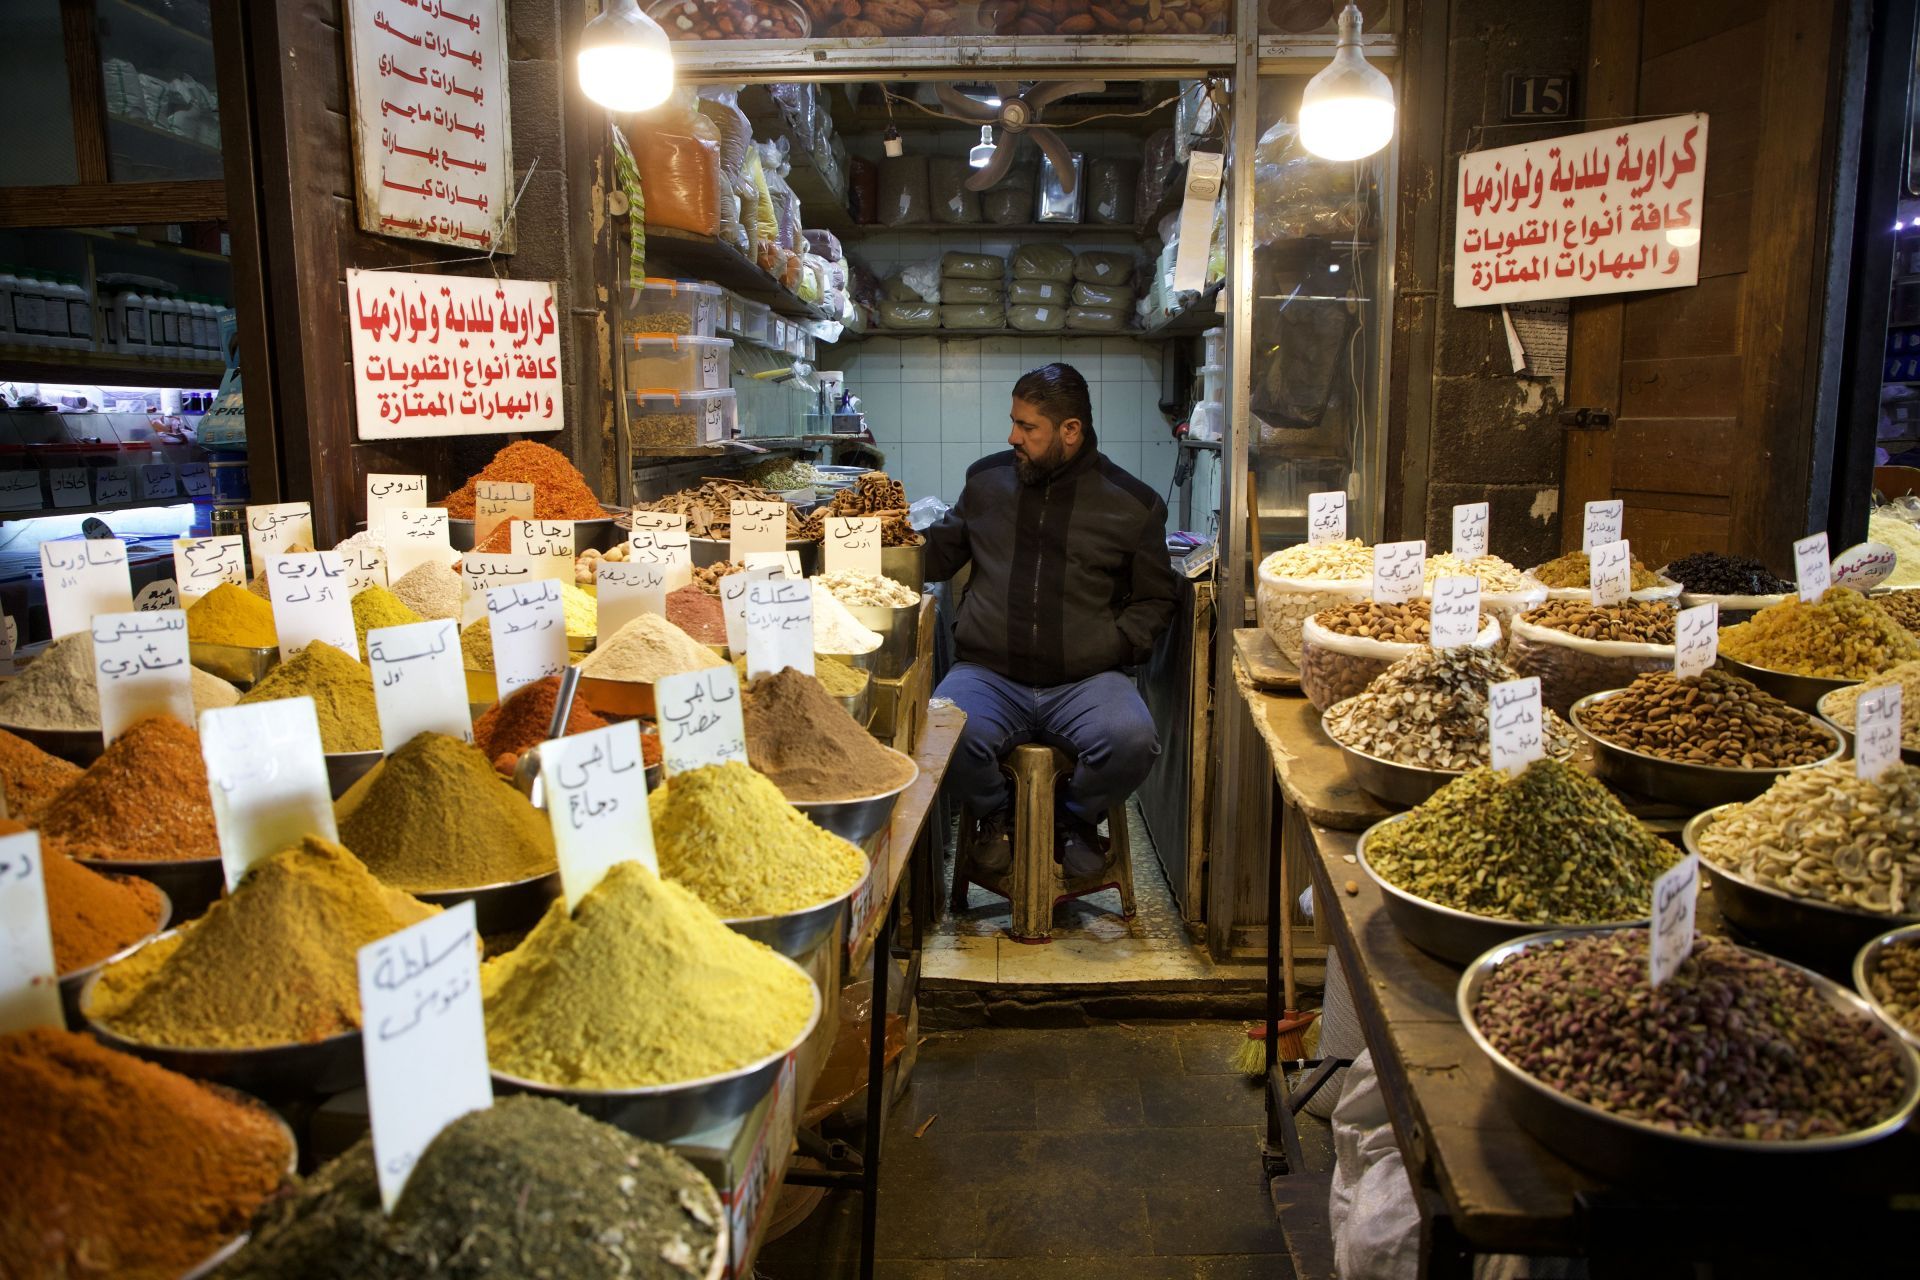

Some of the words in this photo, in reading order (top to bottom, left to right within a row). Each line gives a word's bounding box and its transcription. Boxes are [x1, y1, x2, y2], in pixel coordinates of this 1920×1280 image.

[374, 10, 421, 46] سمك
[425, 31, 482, 70] بهارات
[379, 53, 428, 85] كاري
[430, 64, 484, 106] بهارات
[381, 98, 431, 124] ماجي
[1522, 79, 1564, 114] 15
[434, 106, 485, 142] بهارات
[382, 127, 439, 169] بهارات
[441, 149, 487, 175] سبع
[1616, 126, 1698, 199] كراوية
[1463, 158, 1543, 216] ولوازمها
[1549, 147, 1610, 208] بلدية
[435, 179, 488, 213] بهارات
[439, 217, 491, 246] بهارات
[1563, 205, 1622, 249] أنواع
[1630, 199, 1692, 231] كافة
[1471, 256, 1548, 291] الممتازة
[357, 287, 440, 344] ولوازمها
[440, 286, 494, 349] بلدية
[495, 290, 555, 349] كراوية
[463, 353, 510, 388] أنواع
[514, 353, 557, 379] كافة
[377, 391, 454, 424] الممتازة
[371, 475, 424, 498] أندومي
[476, 484, 531, 503] فليفلة
[1317, 494, 1344, 513] لوز
[1460, 505, 1486, 524] لوز
[44, 541, 125, 568] شاورما
[633, 533, 688, 550] سماق
[1383, 543, 1422, 561] لوز
[1597, 543, 1625, 567] لوز
[465, 562, 528, 578] مندي
[486, 580, 559, 613] فليفلة
[750, 585, 810, 604] مشكلة
[1442, 576, 1479, 598] لوز
[1682, 604, 1714, 636] لوز
[370, 623, 450, 663] كبة
